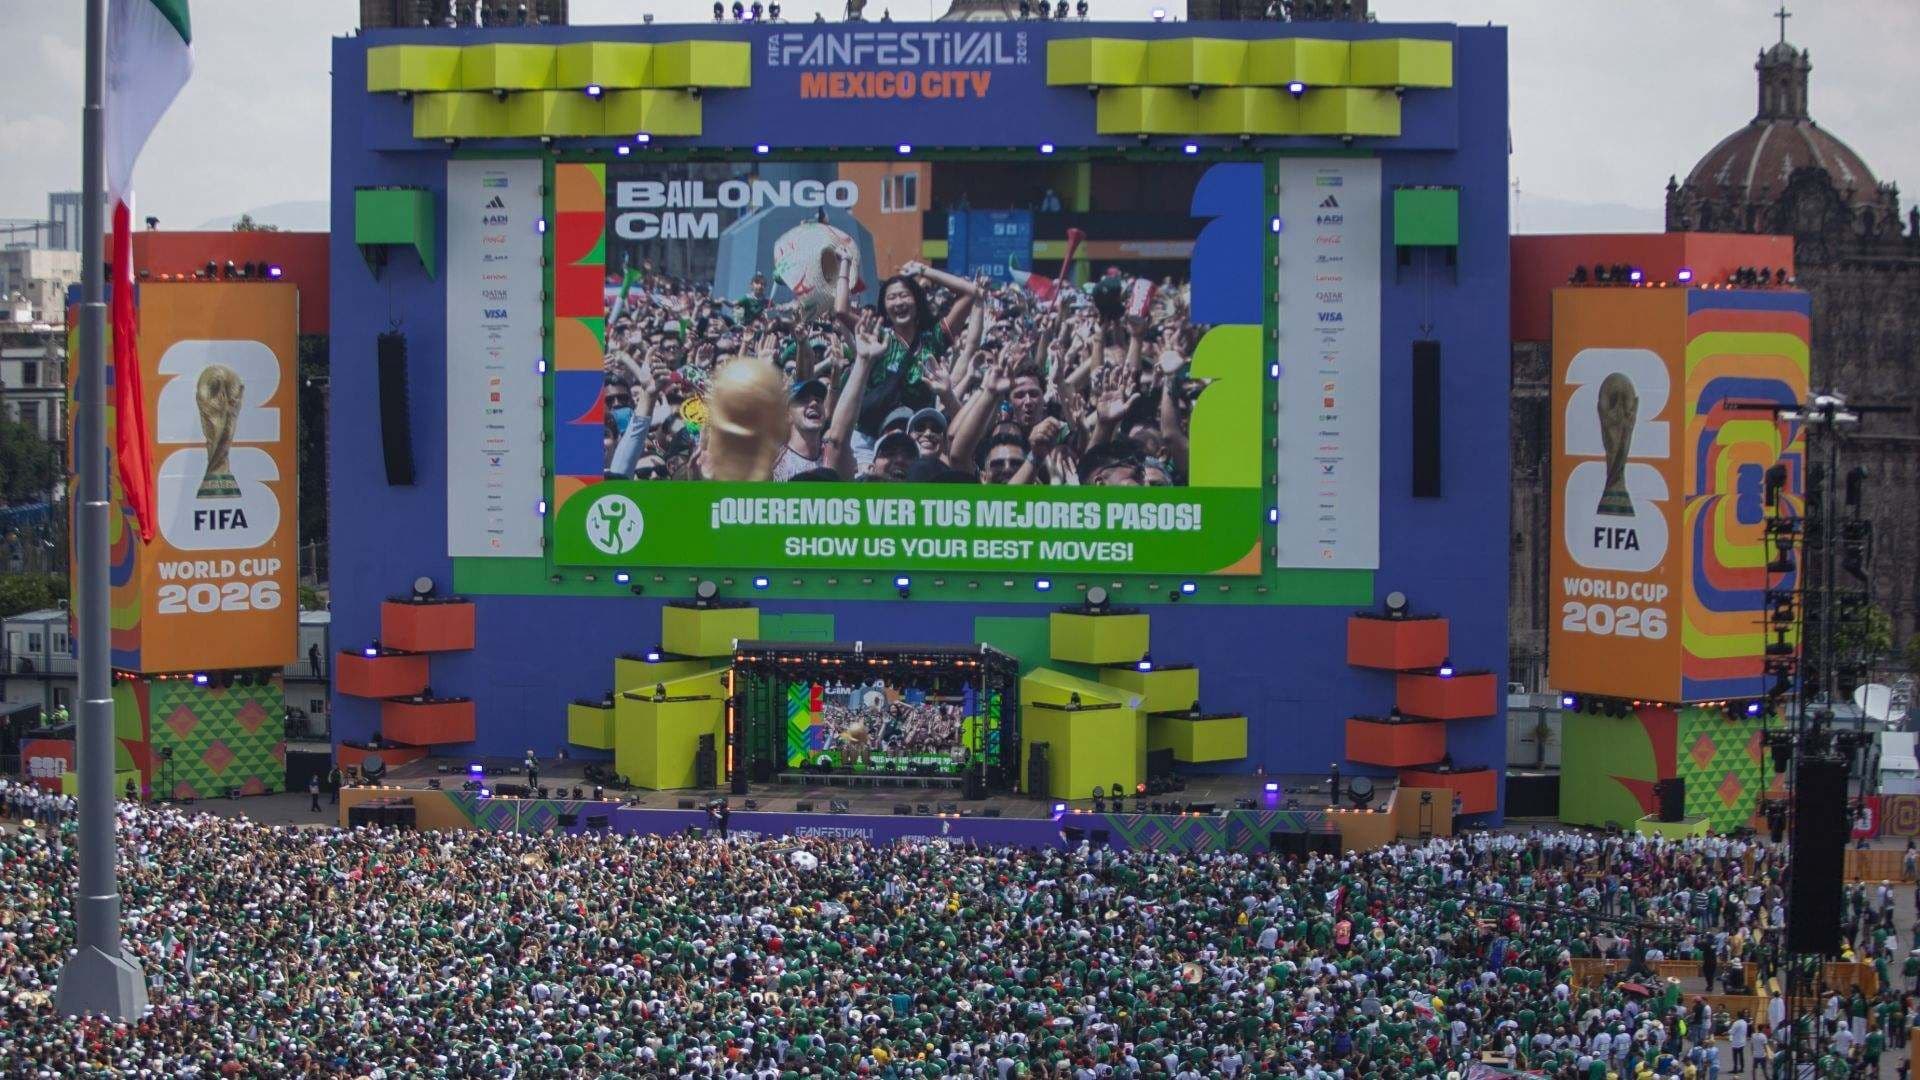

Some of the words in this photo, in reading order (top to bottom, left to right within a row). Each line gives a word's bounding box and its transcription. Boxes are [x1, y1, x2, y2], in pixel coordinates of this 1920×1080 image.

[768, 34, 780, 66] FIFA
[1017, 31, 1028, 64] 2026
[801, 71, 915, 99] MEXICO
[921, 71, 991, 98] CITY
[616, 180, 859, 208] BAILONGO
[615, 211, 719, 240] CAM
[485, 309, 508, 318] VISA
[1318, 312, 1343, 321] VISA
[194, 508, 248, 531] FIFA
[711, 498, 861, 529] ¡QUEREMOS
[866, 499, 916, 526] VER
[921, 499, 971, 527] TUS
[976, 500, 1101, 529] MEJORES
[1107, 502, 1202, 530] PASOS!
[785, 537, 859, 556] SHOW
[864, 538, 896, 556] US
[901, 538, 967, 558] YOUR
[973, 539, 1034, 559] BEST
[1039, 541, 1133, 561] MOVES!
[1594, 526, 1640, 550] FIFA
[158, 560, 235, 581] WORLD
[239, 558, 281, 577] CUP
[158, 581, 281, 614] 2026
[1563, 577, 1629, 599] WORLD
[1631, 581, 1668, 602] CUP
[1562, 602, 1667, 640] 2026
